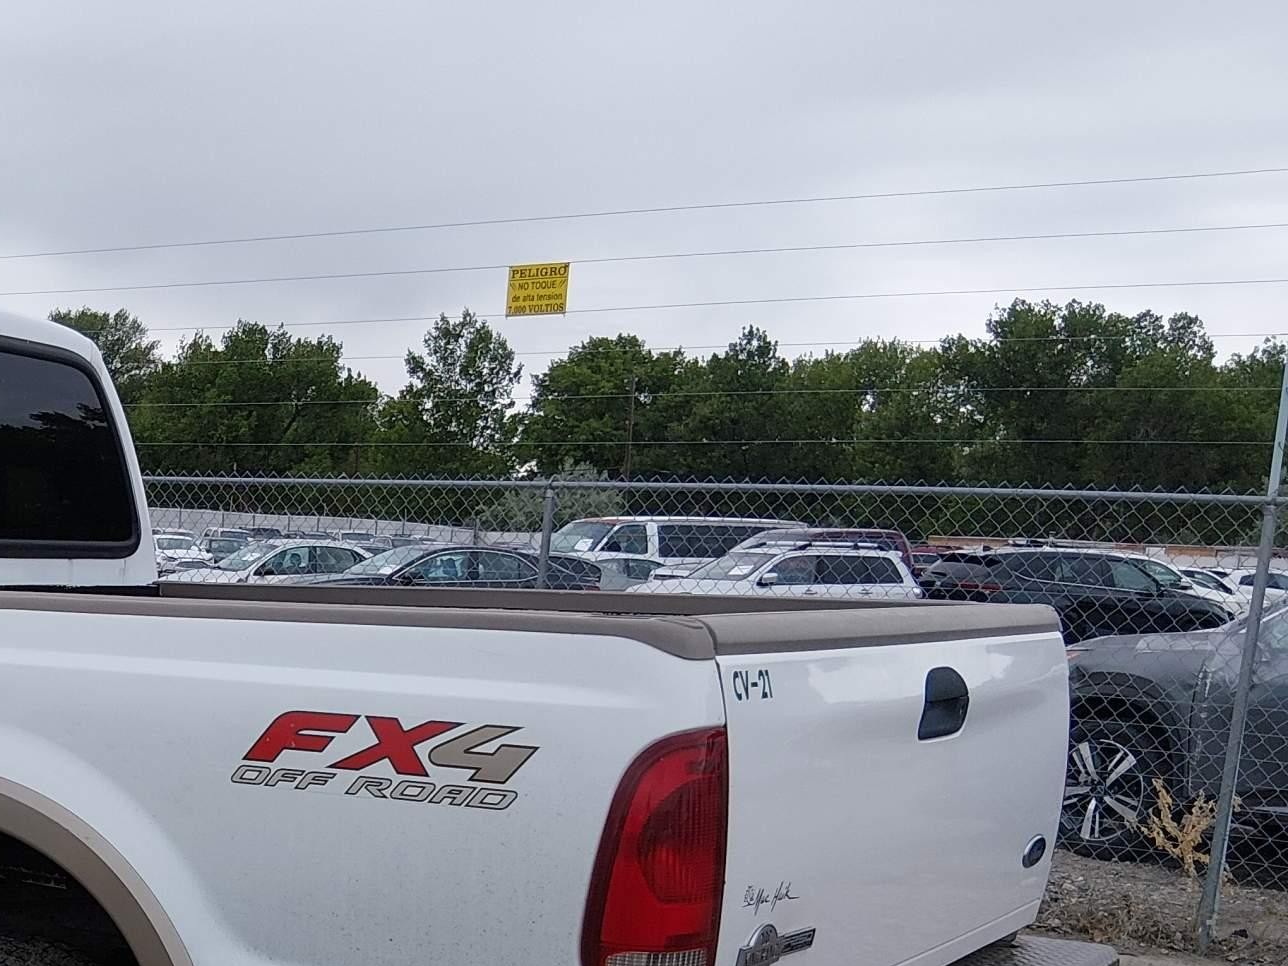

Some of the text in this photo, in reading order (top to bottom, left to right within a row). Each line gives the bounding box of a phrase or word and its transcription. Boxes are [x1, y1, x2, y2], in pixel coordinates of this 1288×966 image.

[512, 266, 567, 279] PELIGRO
[518, 280, 557, 291] NO TOQUE
[512, 294, 521, 303] de
[528, 302, 564, 313] VOLTIOS
[732, 669, 773, 701] CV-21
[242, 710, 540, 785] FX4
[230, 764, 518, 810] OFF ROAD
